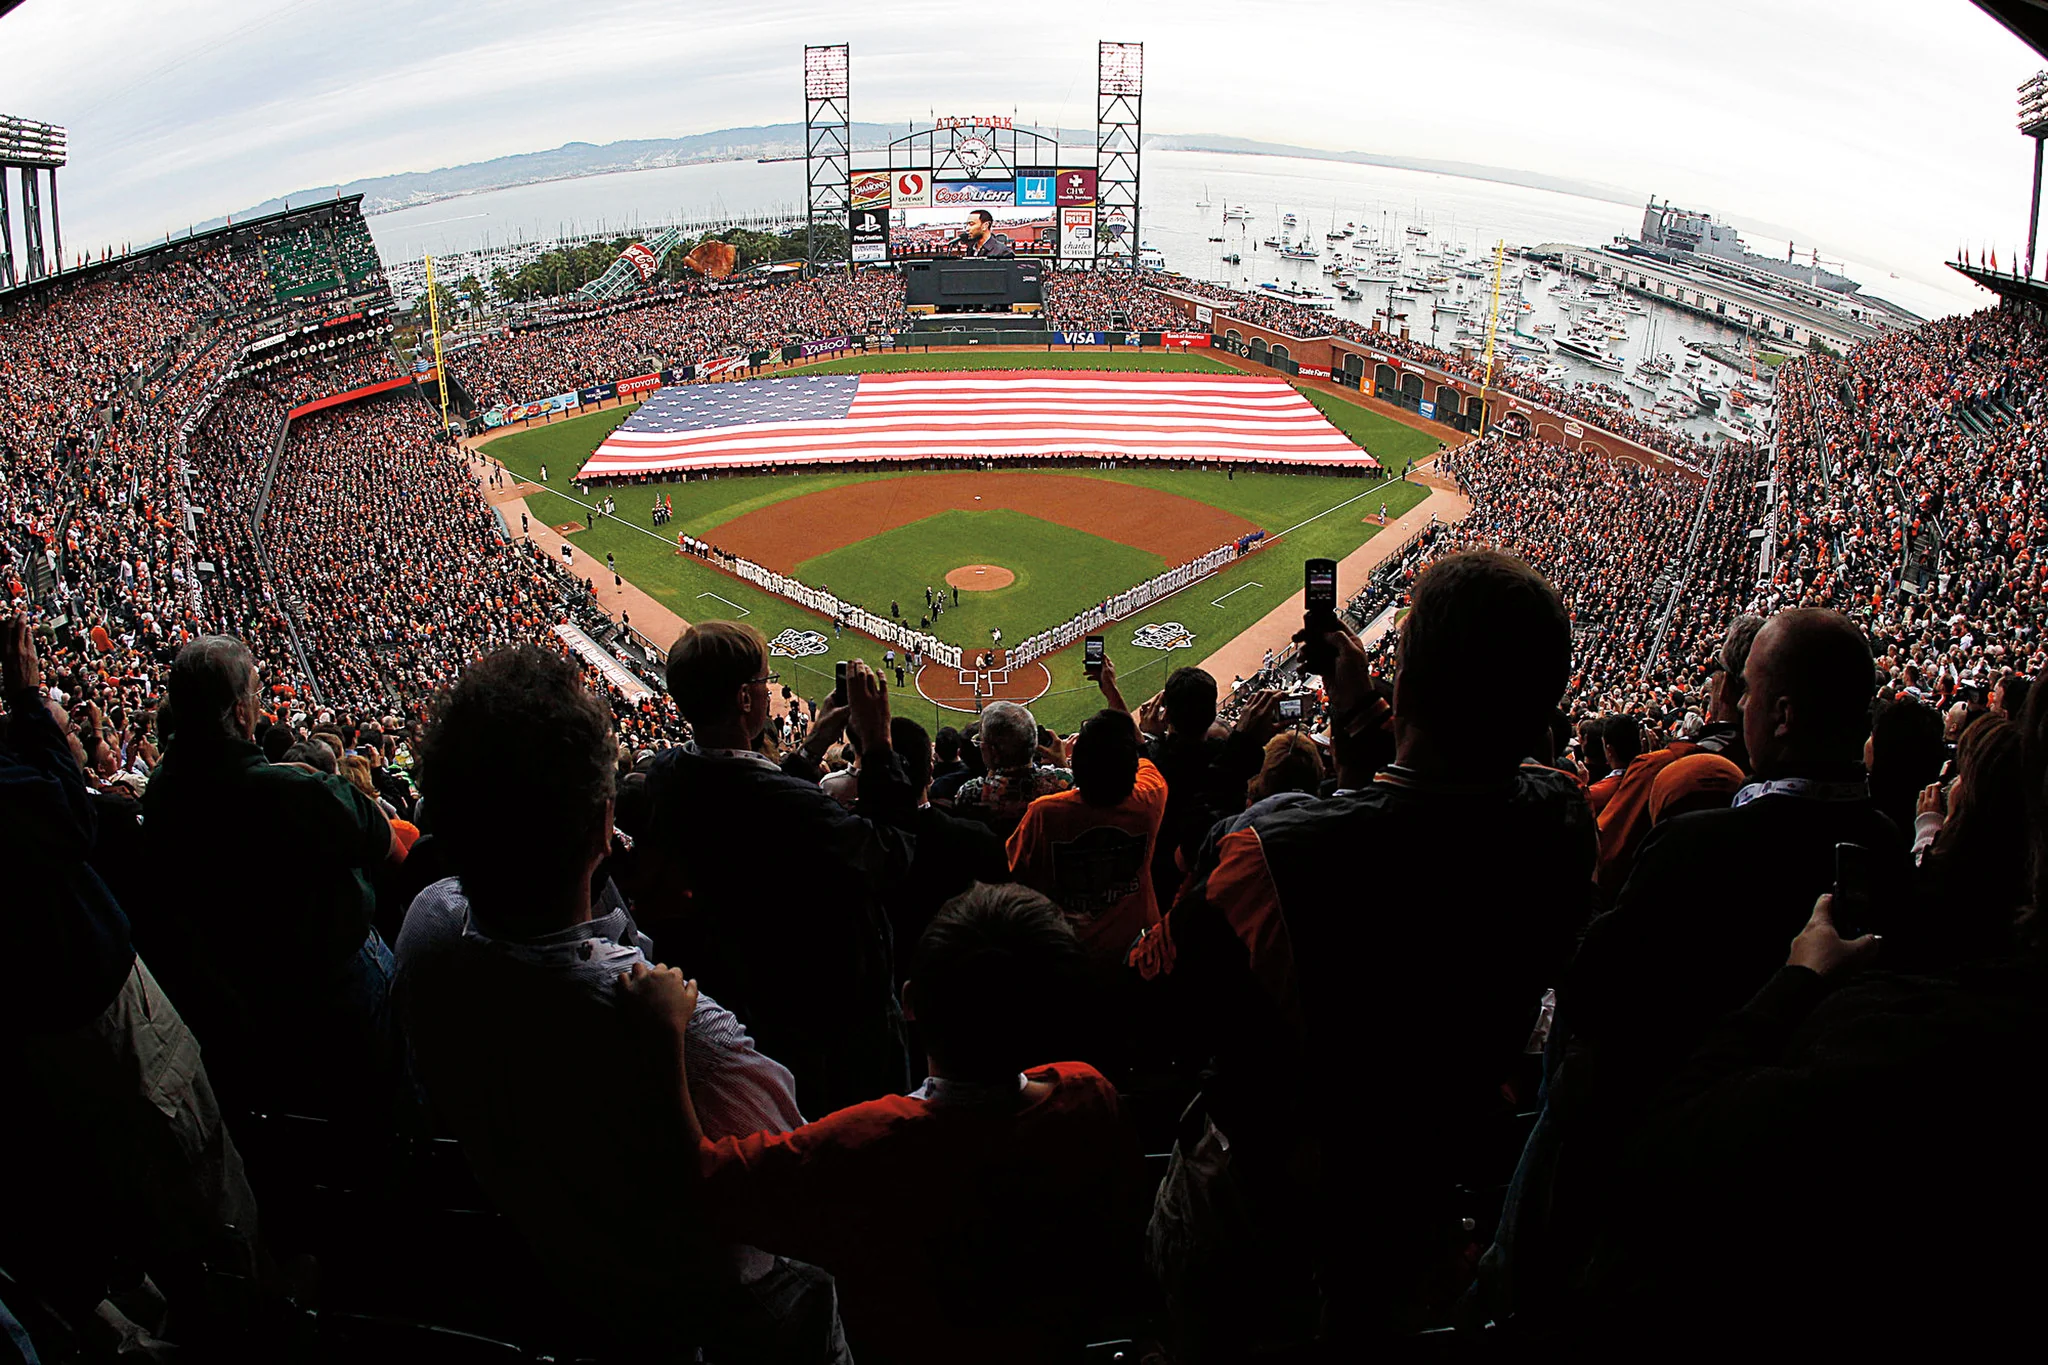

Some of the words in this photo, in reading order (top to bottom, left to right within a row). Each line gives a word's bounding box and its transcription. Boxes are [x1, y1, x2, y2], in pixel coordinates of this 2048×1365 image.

[936, 117, 969, 130] AT&T
[975, 117, 1013, 130] PARK
[854, 181, 888, 195] DIAMOND
[935, 187, 971, 203] Coors
[971, 190, 1012, 201] LIGHT
[1065, 215, 1090, 224] RULE
[1064, 241, 1091, 250] charles
[1062, 332, 1095, 344] VISA
[803, 338, 847, 355] YAHOO!
[1298, 367, 1314, 376] State
[1314, 369, 1330, 378] Farm
[630, 377, 660, 389] TOYOTA
